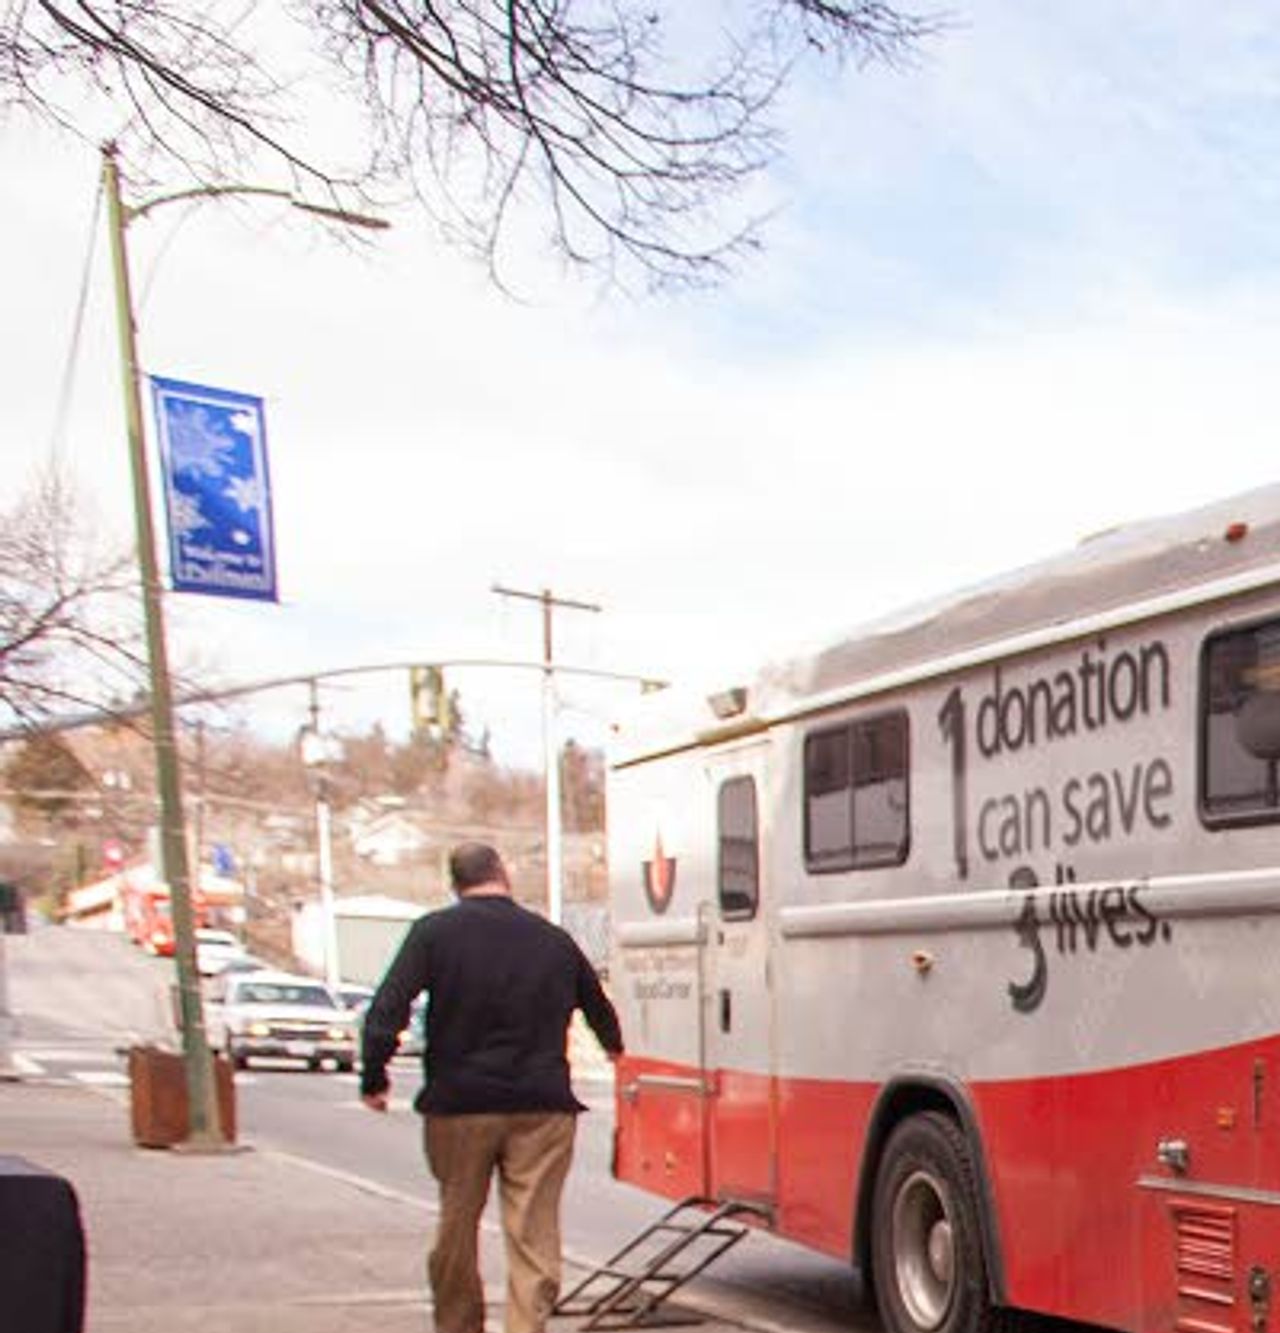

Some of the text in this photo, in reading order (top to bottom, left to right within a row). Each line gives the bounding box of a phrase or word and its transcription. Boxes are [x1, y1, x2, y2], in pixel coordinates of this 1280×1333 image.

[938, 637, 1170, 880] 1 donation
[977, 757, 1173, 862] can save
[1008, 862, 1172, 1014] 3 lives.
